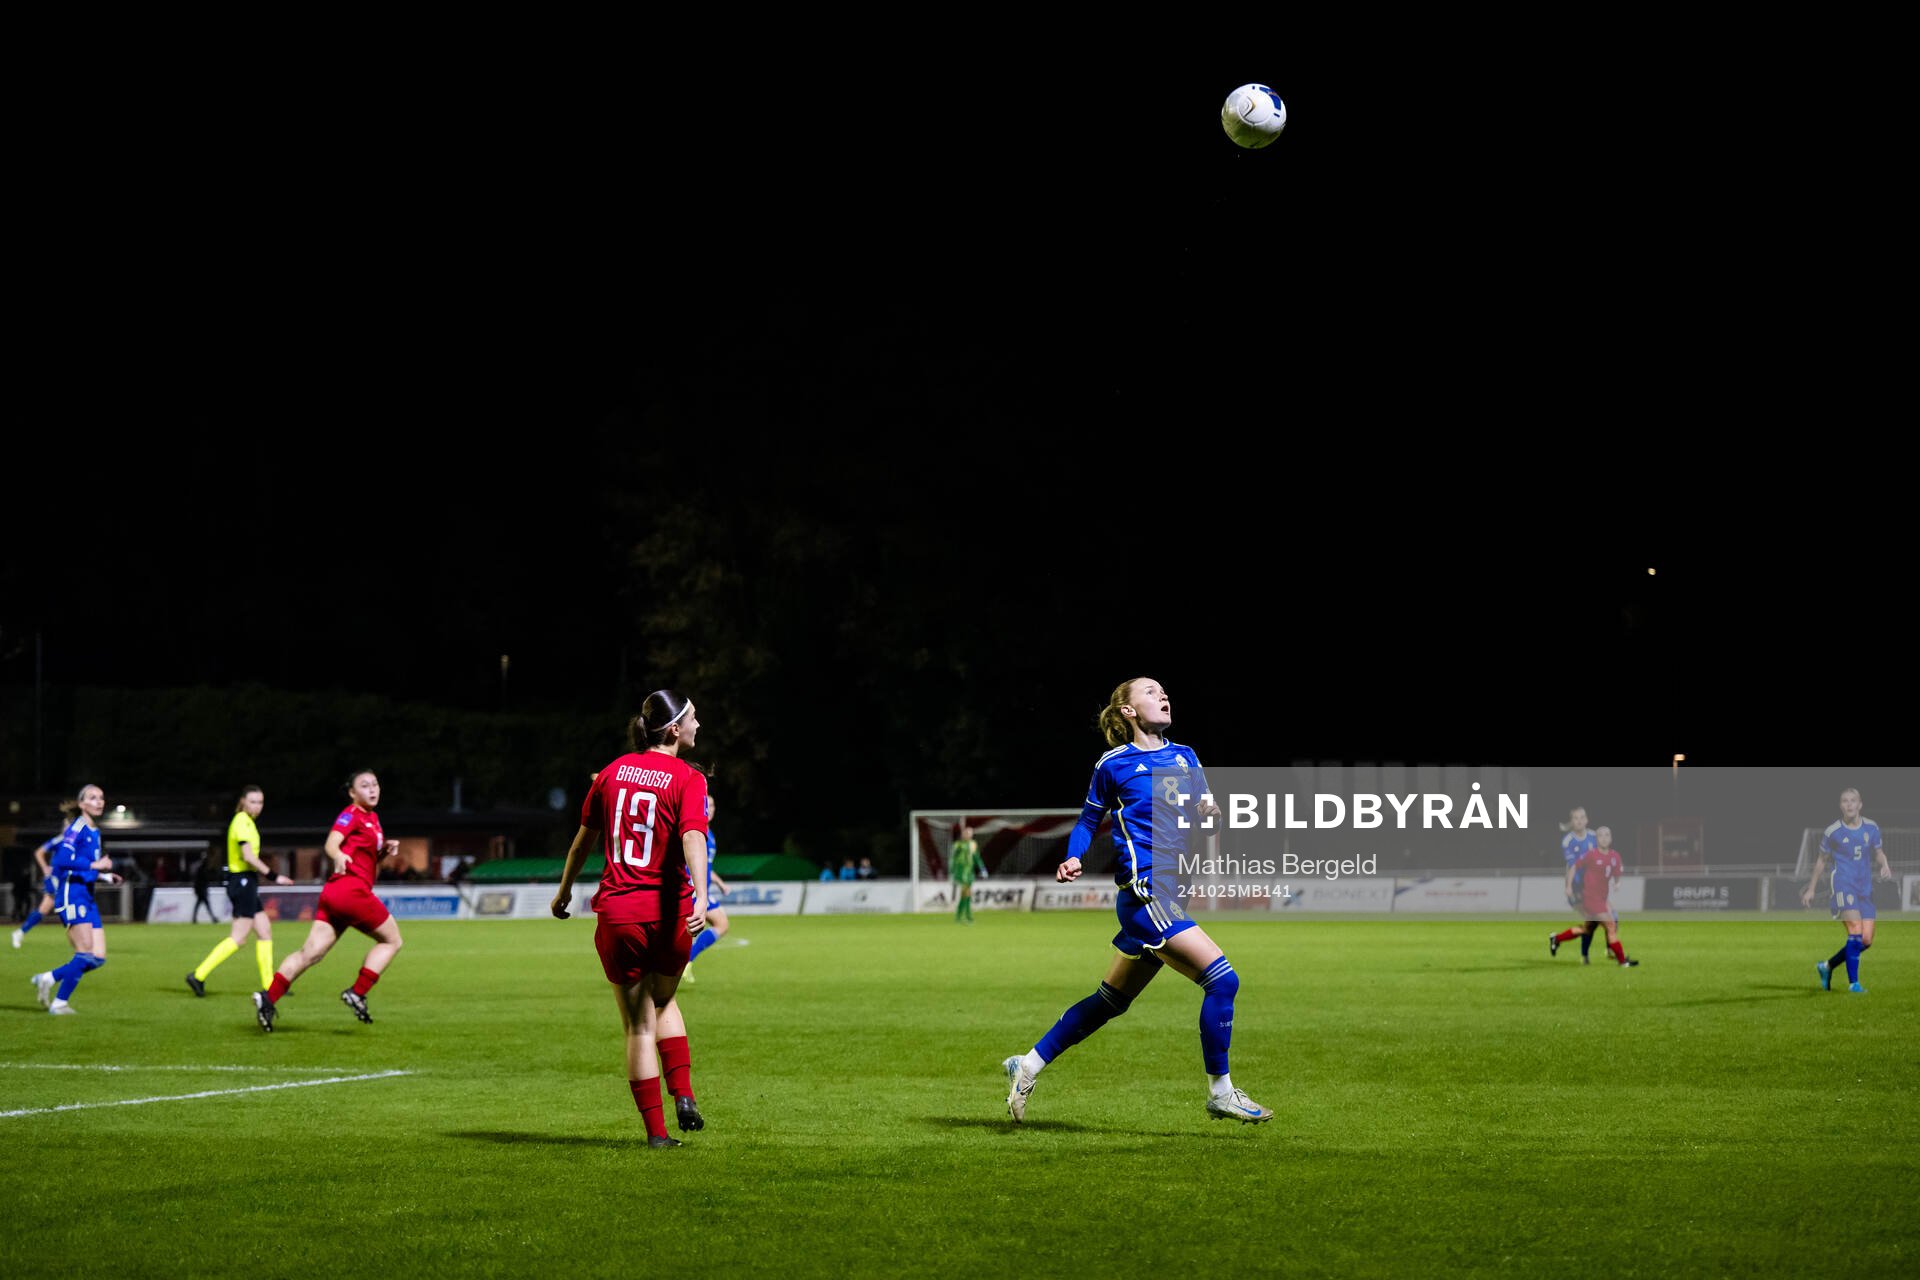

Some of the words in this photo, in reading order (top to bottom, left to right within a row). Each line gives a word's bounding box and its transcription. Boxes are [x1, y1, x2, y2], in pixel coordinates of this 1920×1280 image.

[616, 764, 672, 789] BARBOSA
[1163, 776, 1179, 805] 8
[613, 788, 657, 867] 13
[1853, 845, 1862, 860] 5
